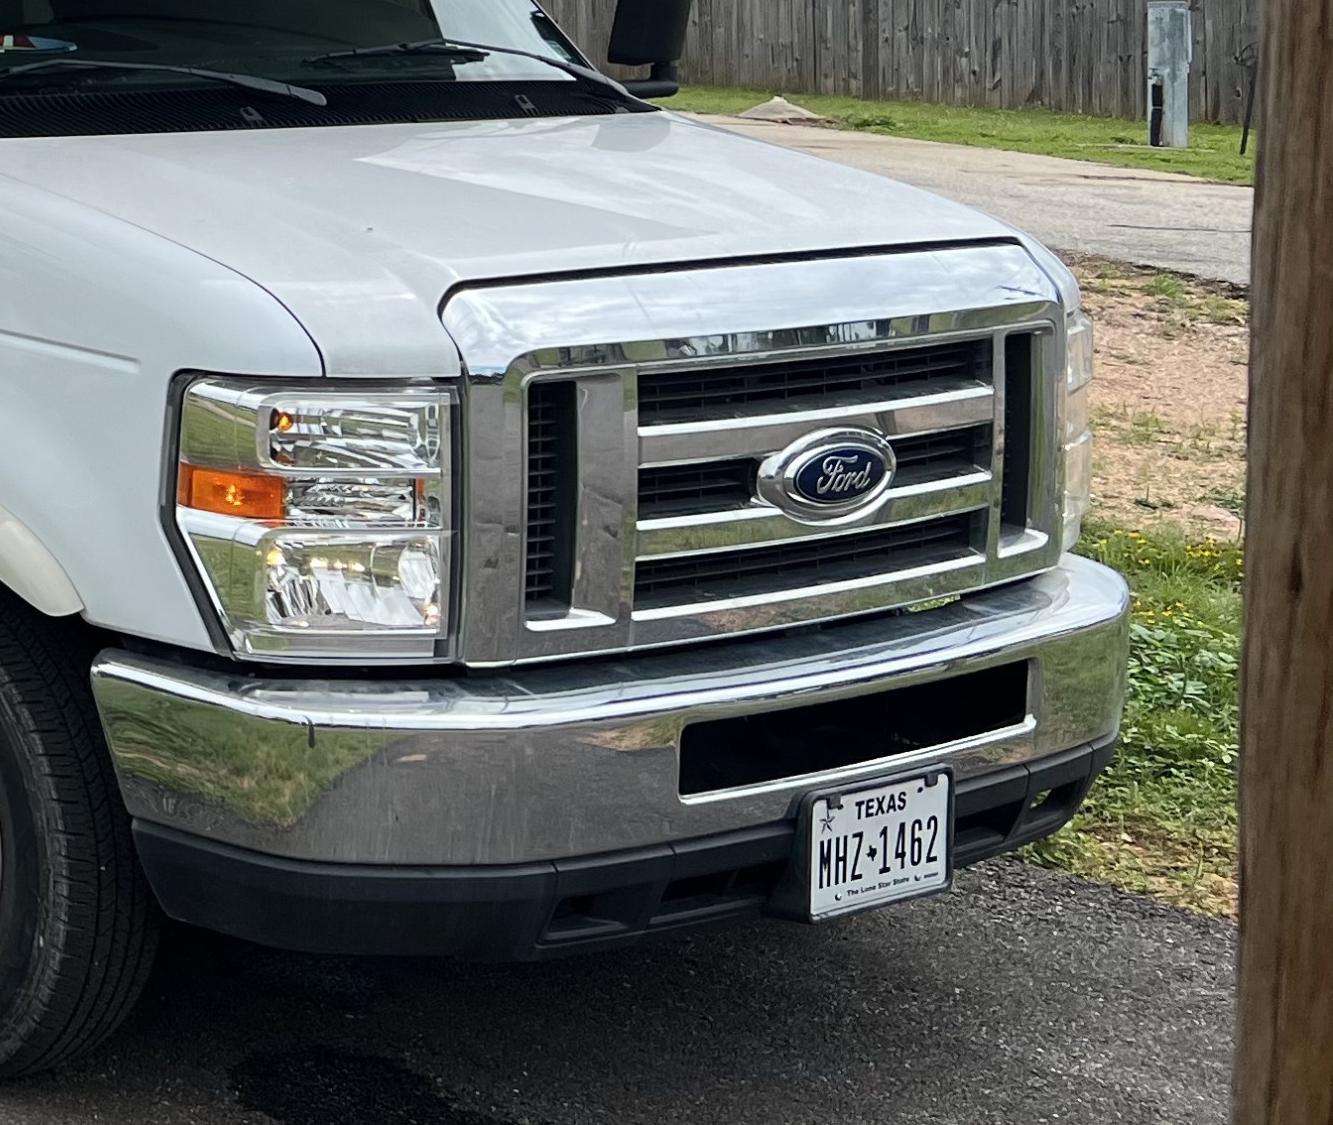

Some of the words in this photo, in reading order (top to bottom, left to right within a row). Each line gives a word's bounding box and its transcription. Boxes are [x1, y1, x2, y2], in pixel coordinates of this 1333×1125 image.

[817, 454, 872, 494] Ford
[855, 791, 907, 820] TEXAS
[847, 887, 859, 897] The
[860, 884, 876, 894] Lone
[878, 881, 892, 890] Star
[893, 877, 910, 887] State
